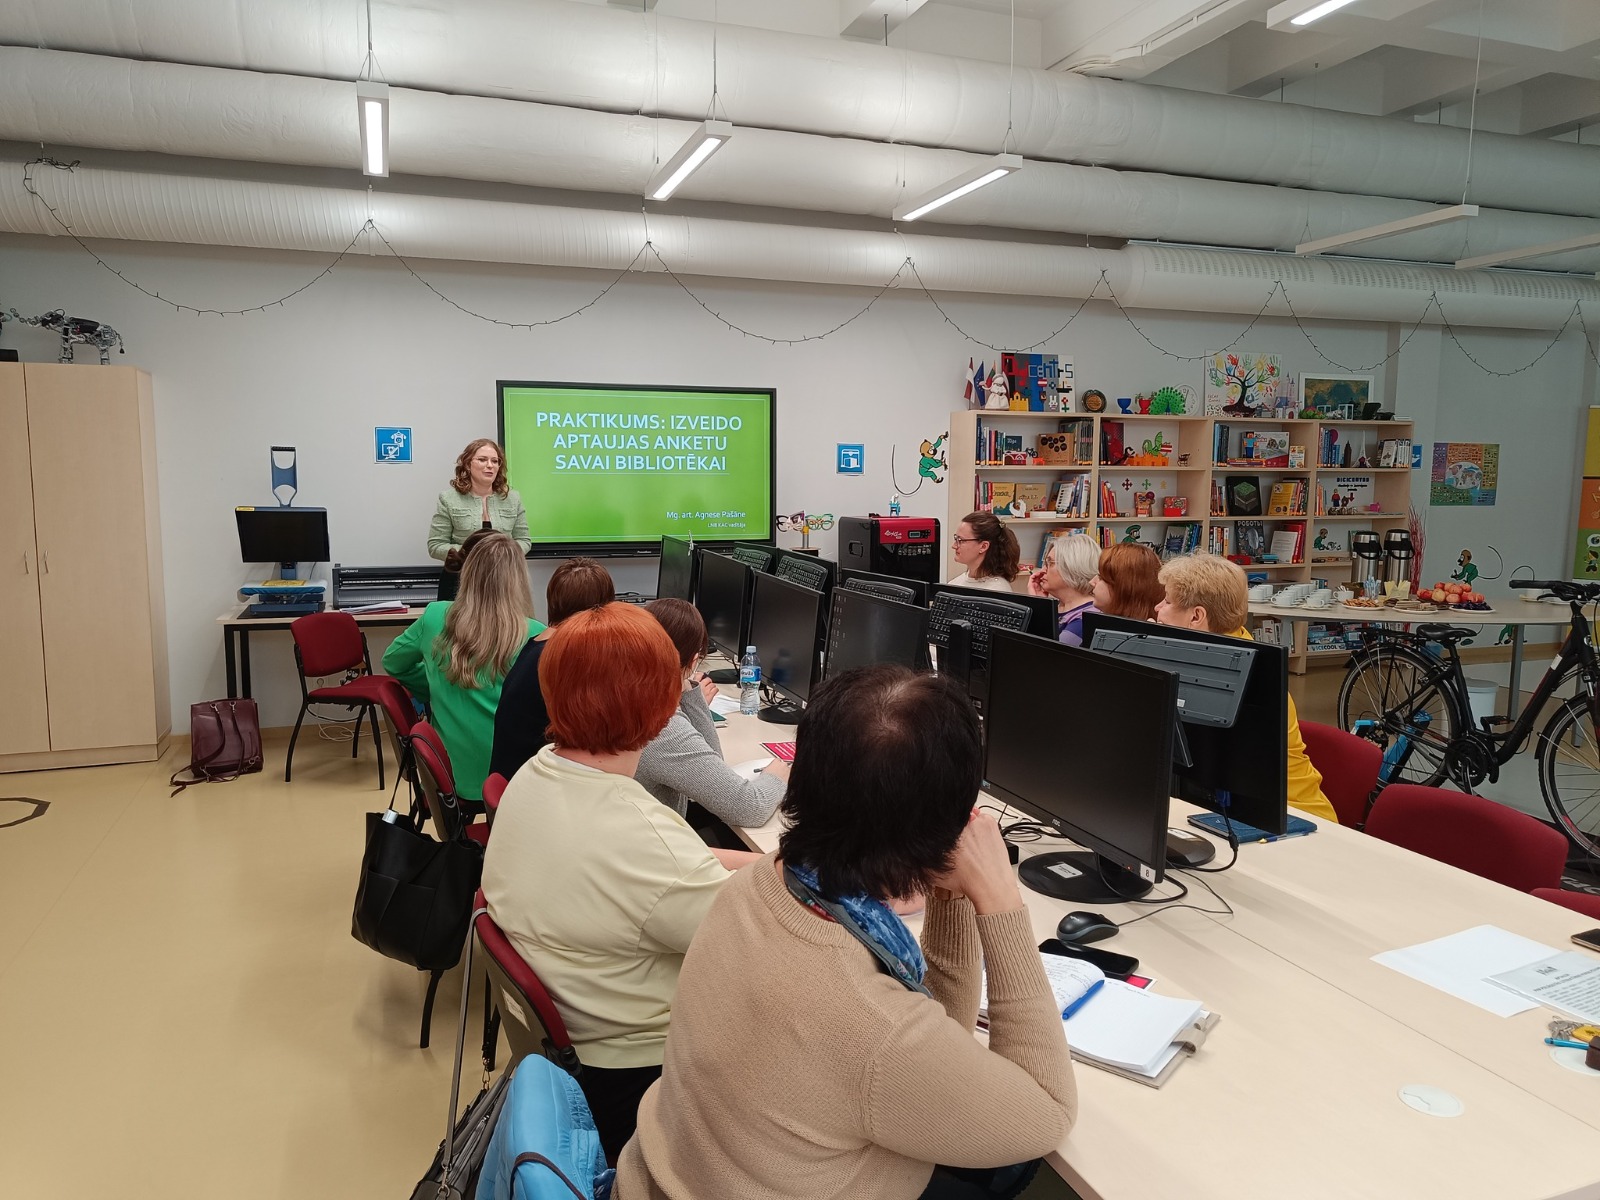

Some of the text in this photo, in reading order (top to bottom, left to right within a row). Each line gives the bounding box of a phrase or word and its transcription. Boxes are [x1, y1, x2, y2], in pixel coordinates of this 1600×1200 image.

[536, 412, 742, 431] PRAKTIKUMS: IZVEIDO
[553, 433, 727, 451] APTAUJAS ANKETU
[555, 453, 726, 471] SAVAI BIBLIOTĒKAI
[666, 511, 681, 520] Mg.
[695, 511, 720, 521] Agnese
[1145, 869, 1150, 878] 8
